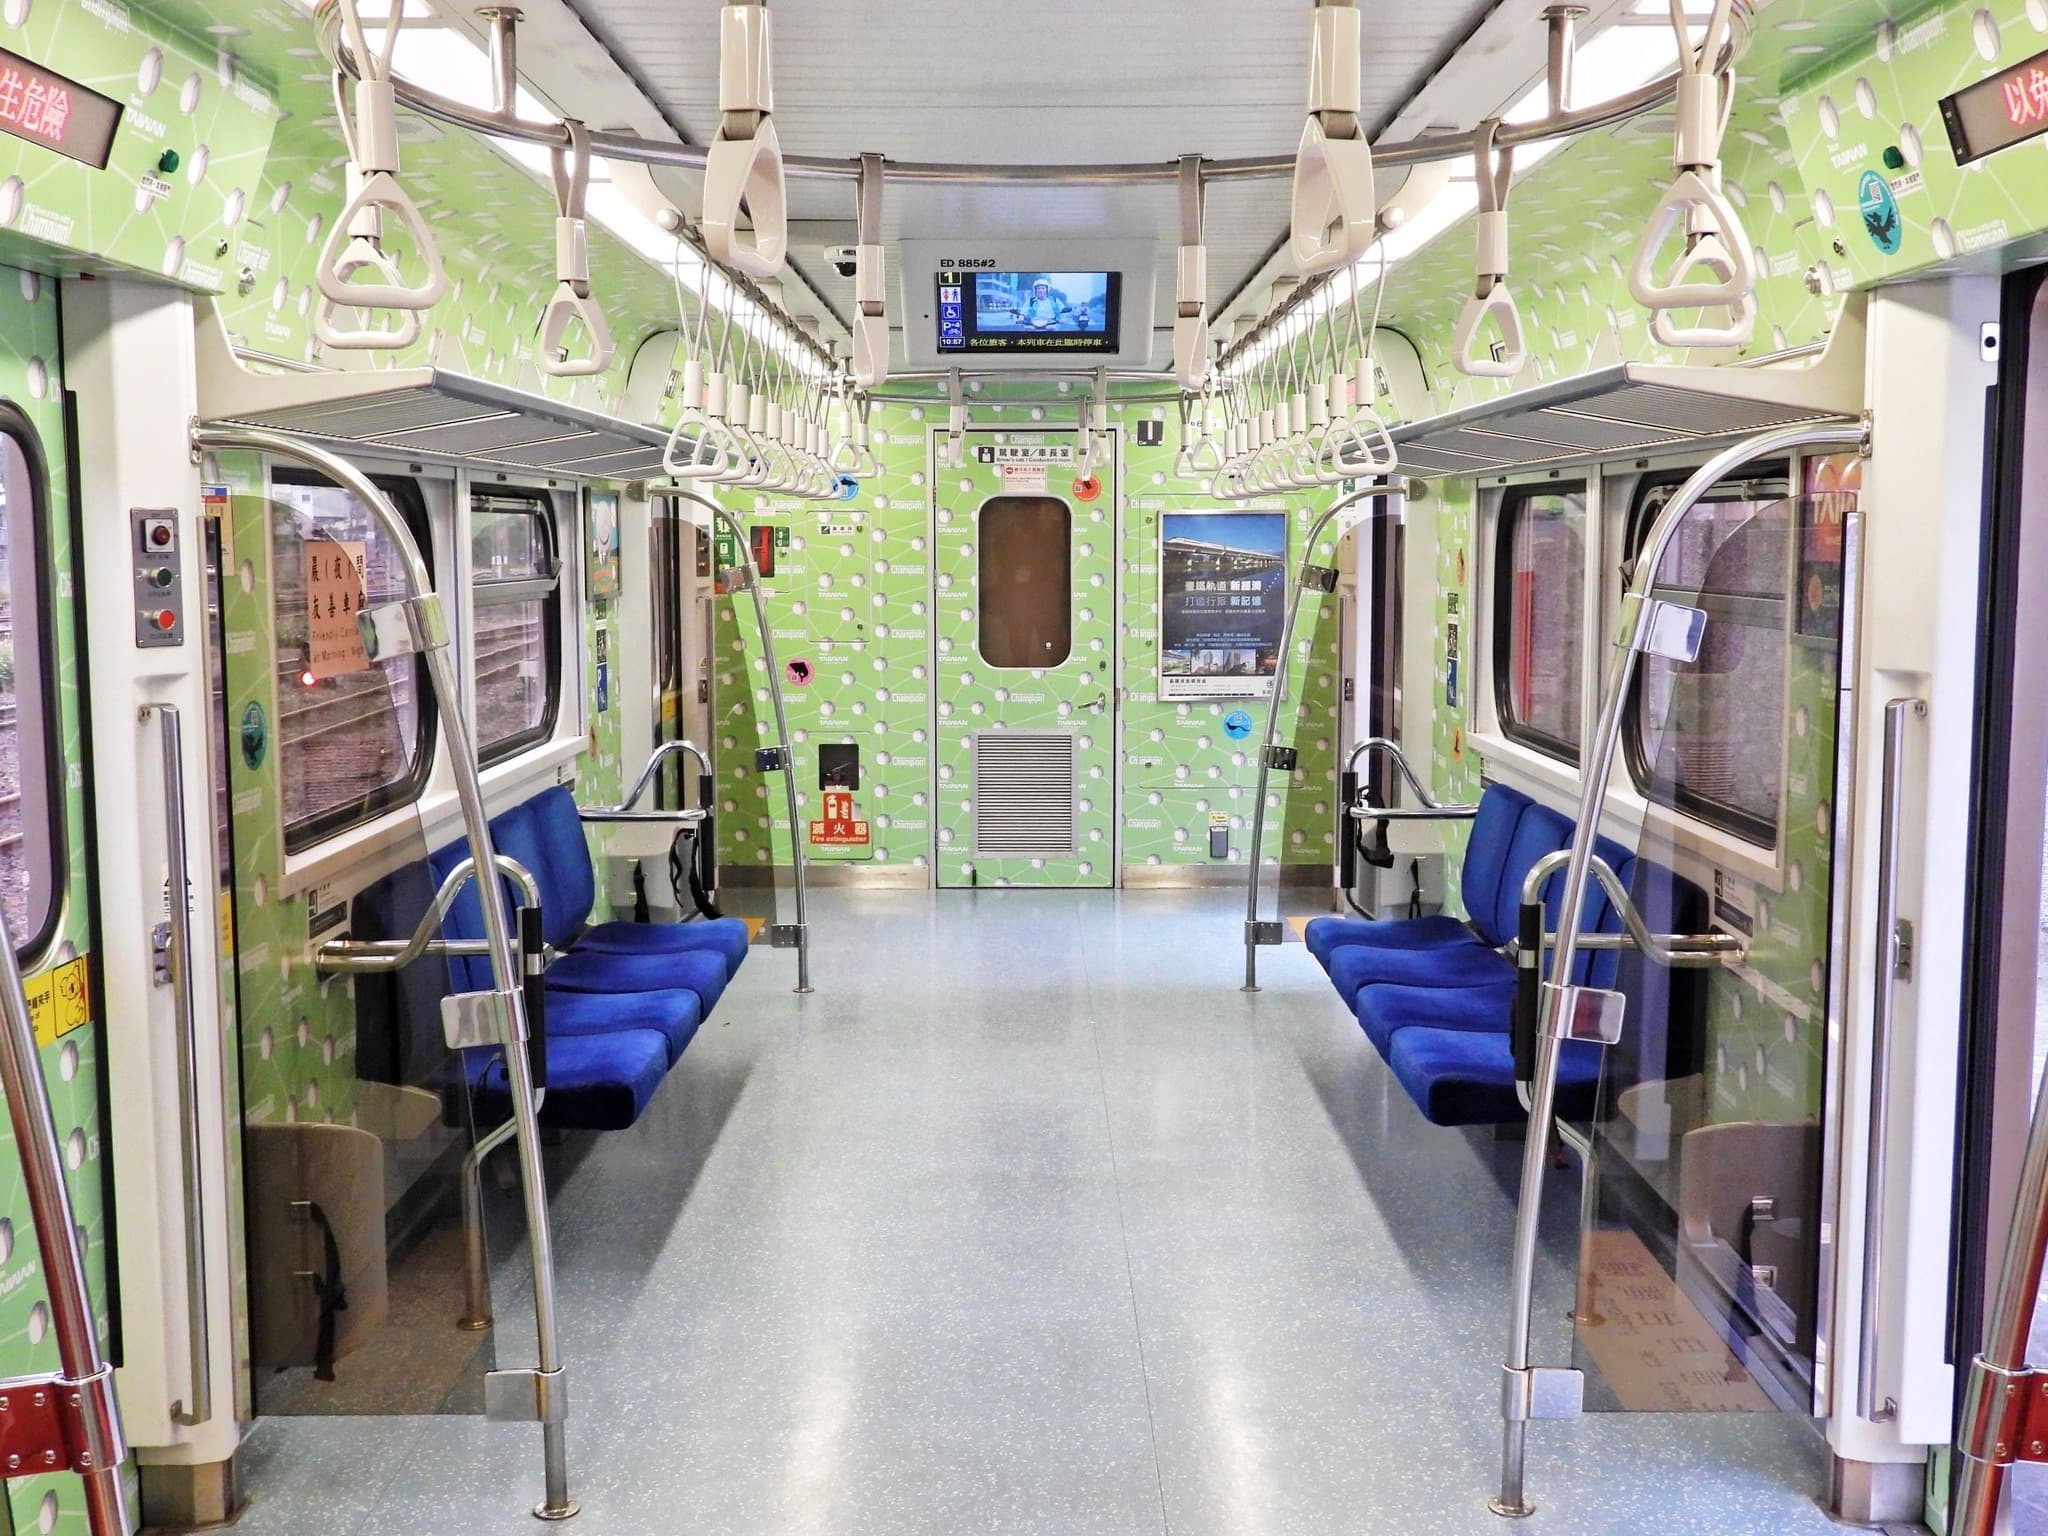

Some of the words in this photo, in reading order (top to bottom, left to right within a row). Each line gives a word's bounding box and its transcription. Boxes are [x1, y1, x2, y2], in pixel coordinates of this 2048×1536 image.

[941, 259, 954, 267] ED
[958, 259, 996, 267] 885#2
[812, 822, 867, 835] 滅火器
